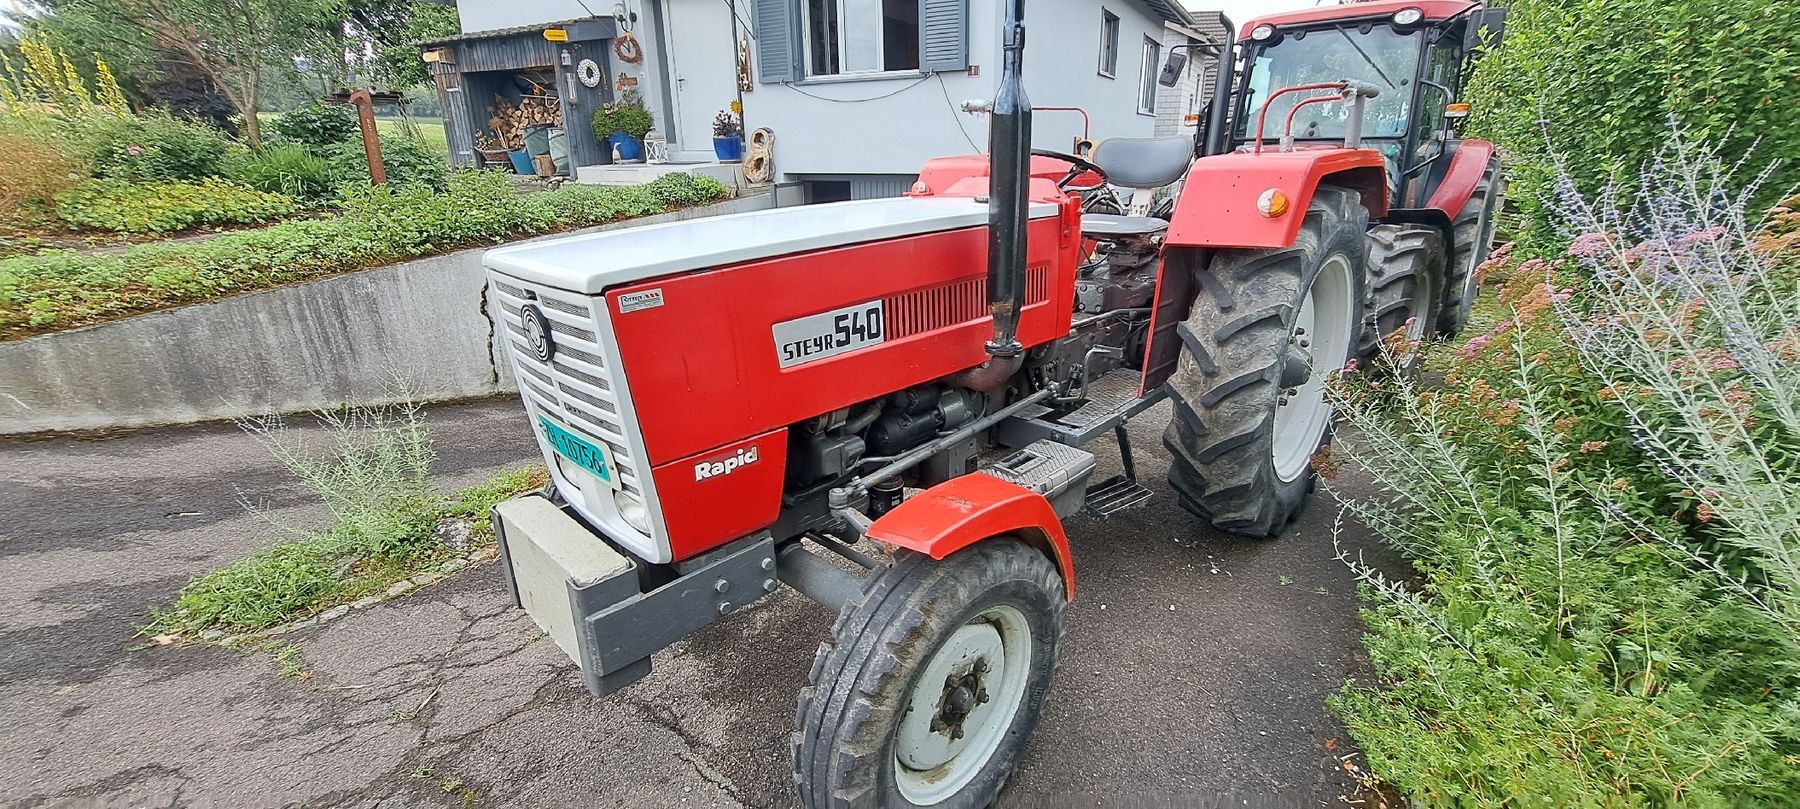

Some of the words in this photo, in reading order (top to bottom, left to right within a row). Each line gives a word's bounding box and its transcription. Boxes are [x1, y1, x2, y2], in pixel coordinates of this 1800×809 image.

[783, 334, 833, 361] STEYR
[834, 307, 881, 348] 540
[695, 446, 758, 482] Rapid
